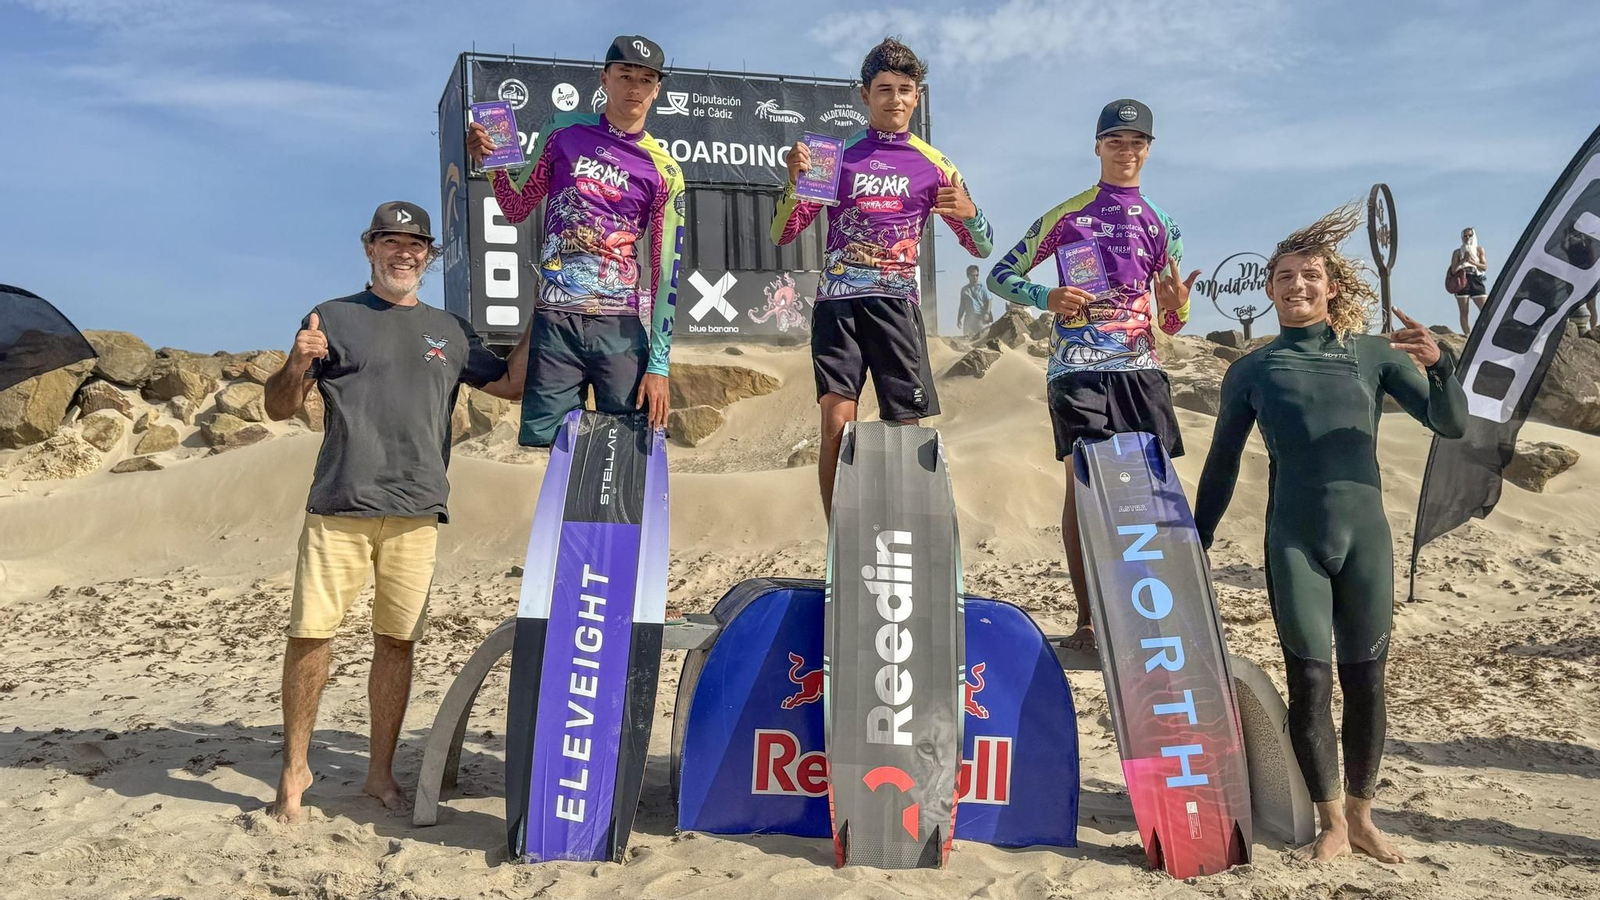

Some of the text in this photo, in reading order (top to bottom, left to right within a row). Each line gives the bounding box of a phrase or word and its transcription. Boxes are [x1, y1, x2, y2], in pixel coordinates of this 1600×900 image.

[693, 93, 741, 107] Diputación
[693, 107, 733, 119] de Cádiz
[769, 115, 799, 124] TUMBAO
[820, 109, 868, 126] VALDEVAQUEROS
[834, 119, 854, 127] TARIFA
[1238, 262, 1269, 281] Ma
[689, 325, 739, 333] blue banana
[1119, 504, 1148, 513] ASTRA
[861, 530, 914, 747] Reedin
[1117, 523, 1209, 788] NORTH
[556, 563, 610, 824] ELEVEIGHT
[752, 729, 829, 797] Re
